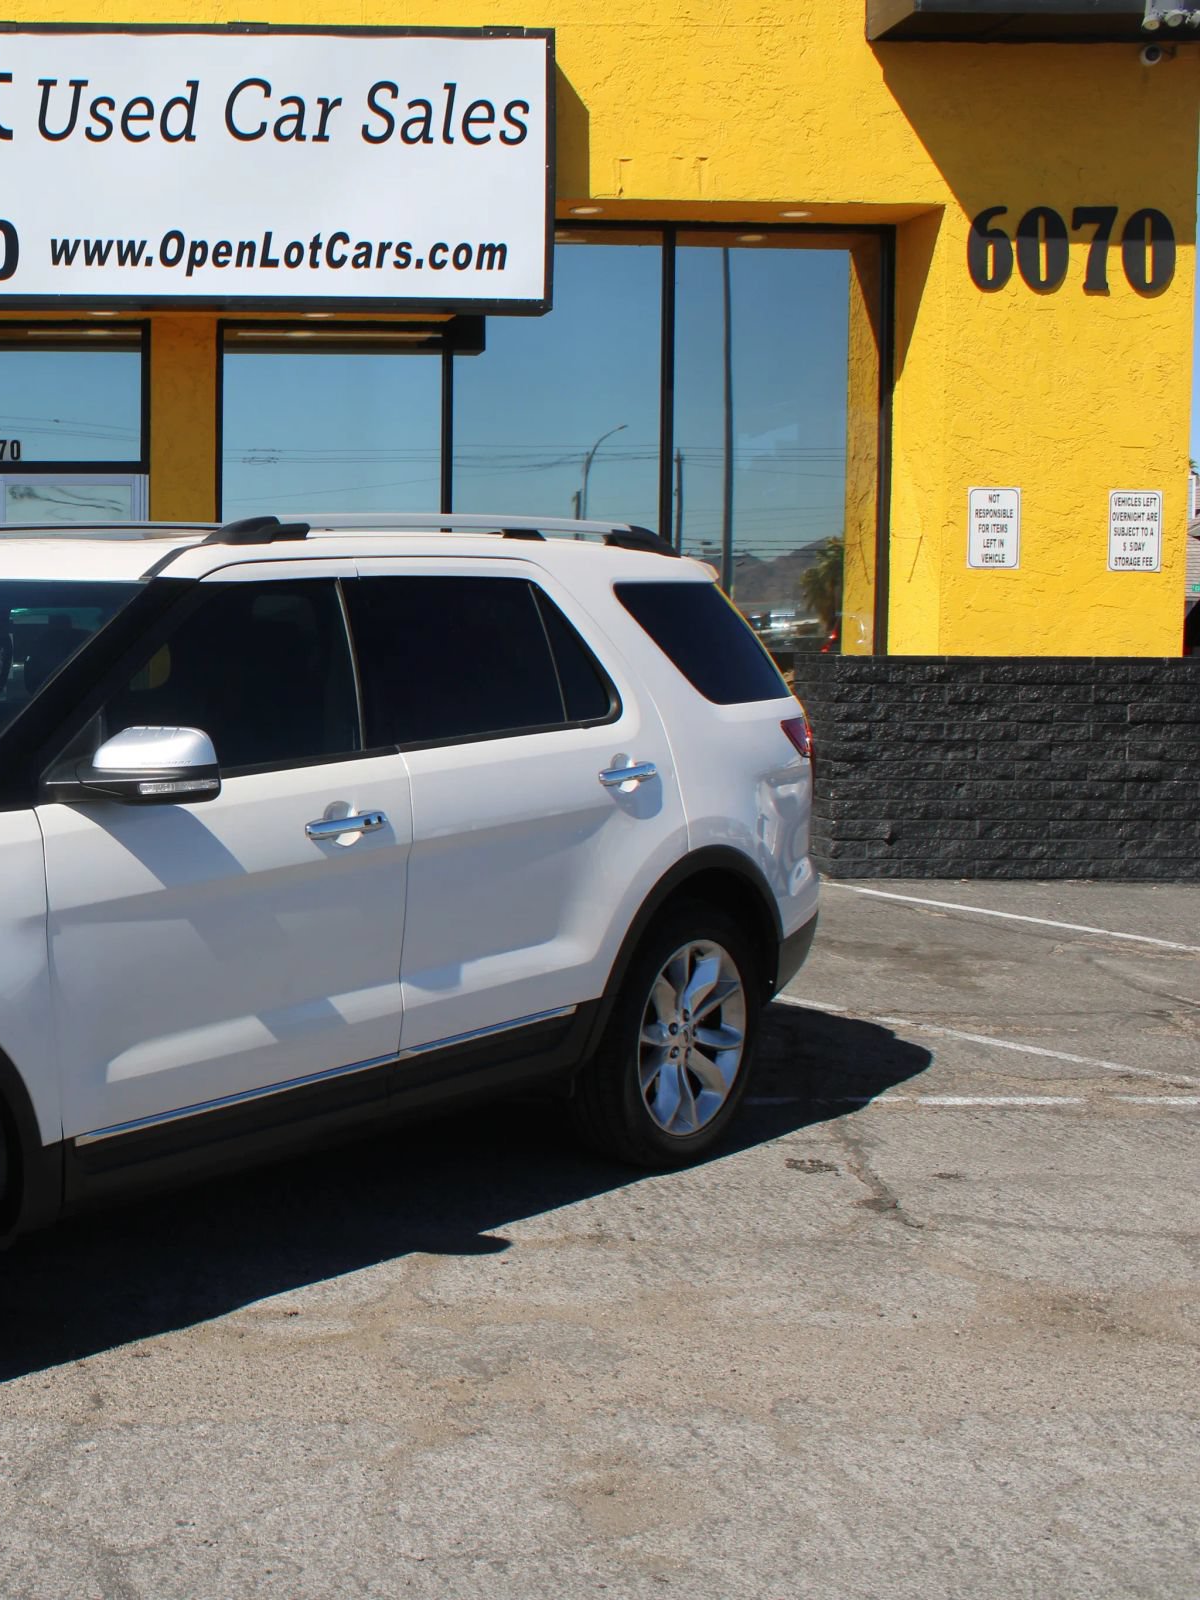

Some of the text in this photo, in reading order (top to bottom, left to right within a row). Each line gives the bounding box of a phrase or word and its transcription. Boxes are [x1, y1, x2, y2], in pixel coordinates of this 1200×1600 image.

[37, 78, 200, 143] Used
[224, 77, 343, 143] Car
[361, 80, 530, 146] Sales
[50, 229, 508, 277] www.OpenLotCars.com
[967, 204, 1176, 293] 6070
[988, 494, 1000, 503] NOT
[1114, 497, 1157, 507] VEHICLES LEFT
[975, 509, 1013, 518] RESPONSIBLE
[1112, 512, 1158, 521] OVERNIGHT ARE
[978, 524, 1008, 533] FOR ITEMS
[1114, 527, 1140, 536] SUBJECT
[1141, 527, 1148, 536] TO
[983, 539, 1005, 548] LEFT IN
[981, 554, 1005, 563] VEHICLE
[1114, 557, 1153, 566] STORAGE FEE
